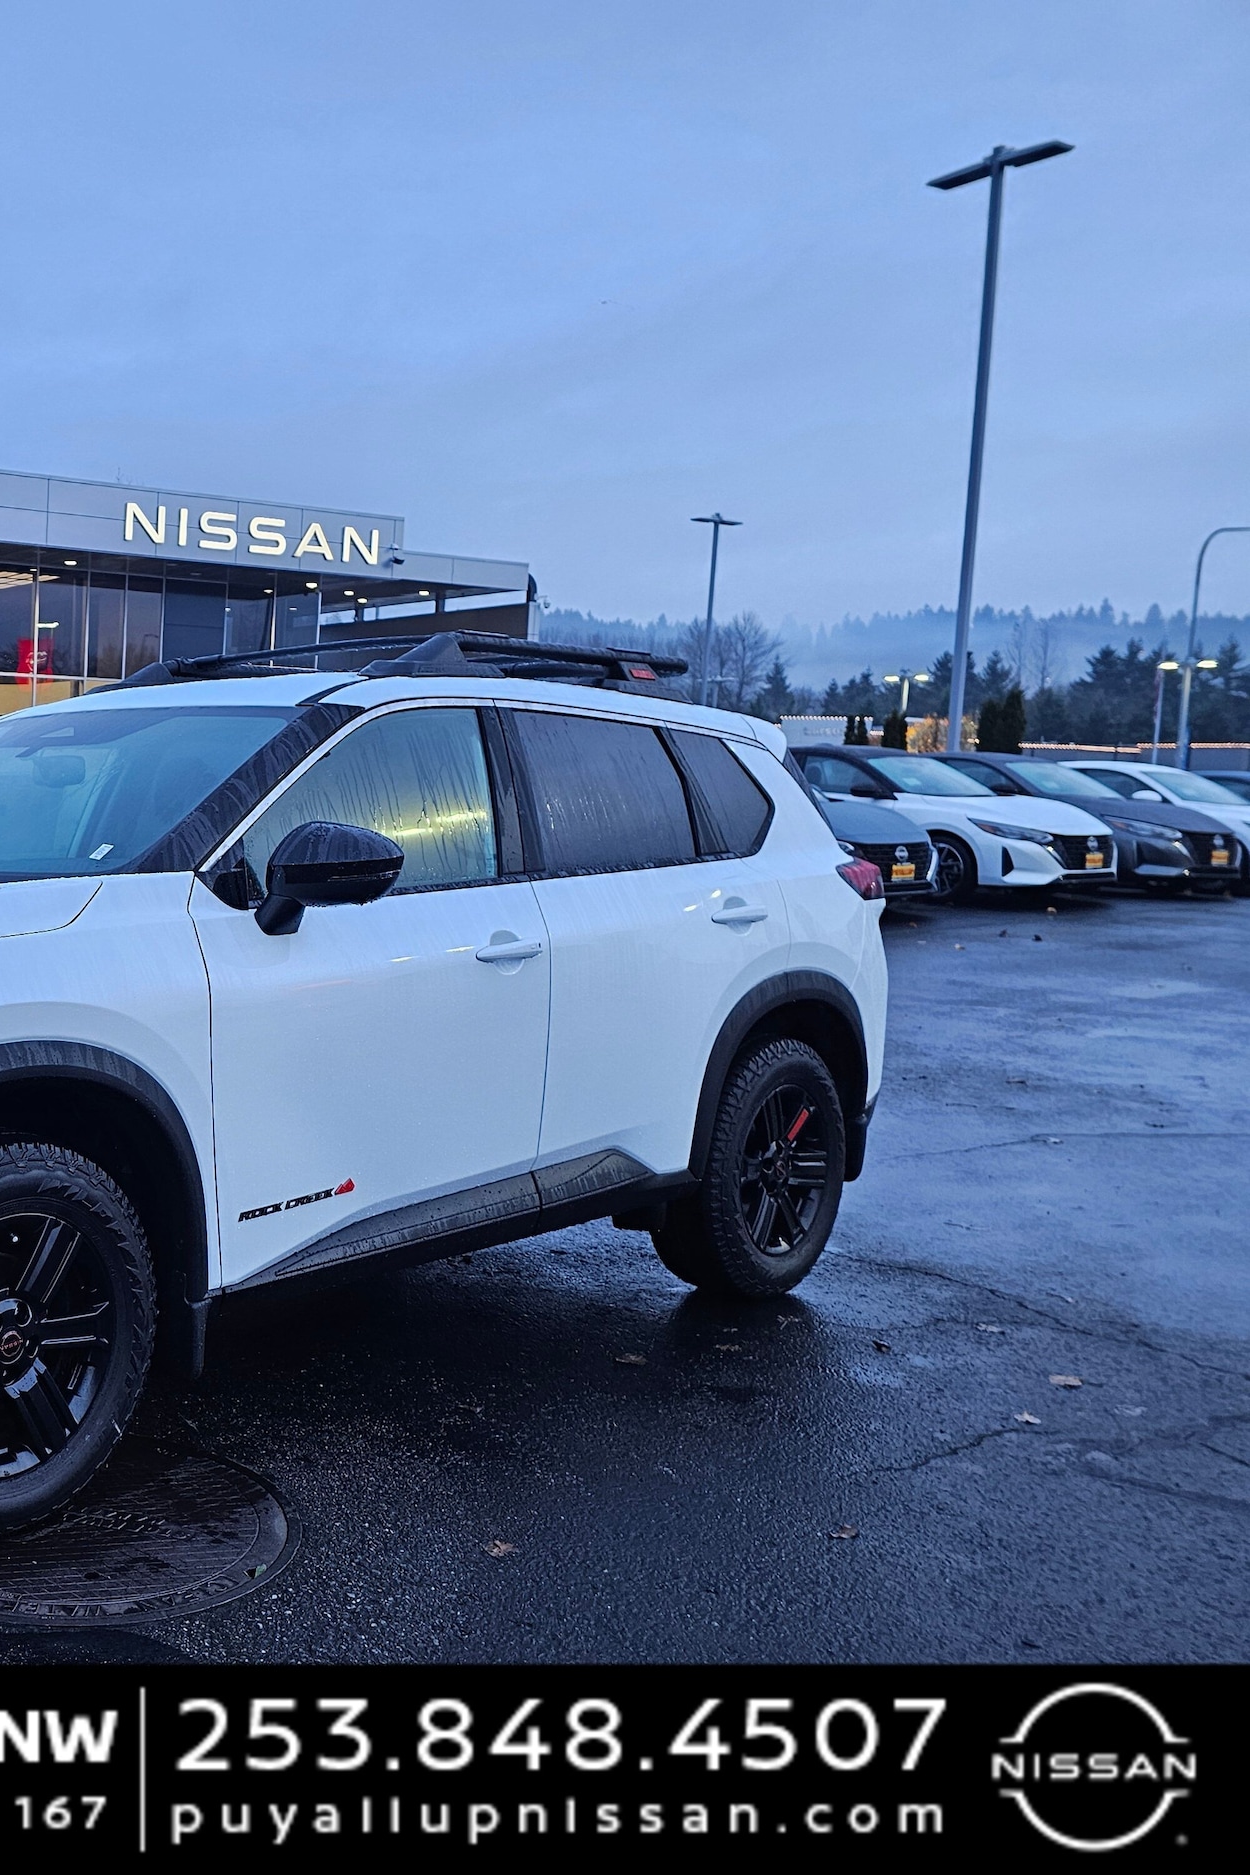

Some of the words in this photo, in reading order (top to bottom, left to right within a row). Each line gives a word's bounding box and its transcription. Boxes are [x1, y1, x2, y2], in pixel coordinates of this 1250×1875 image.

[125, 502, 380, 565] NISSAN
[237, 1201, 284, 1222] ROCK
[284, 1187, 335, 1210] CREEK
